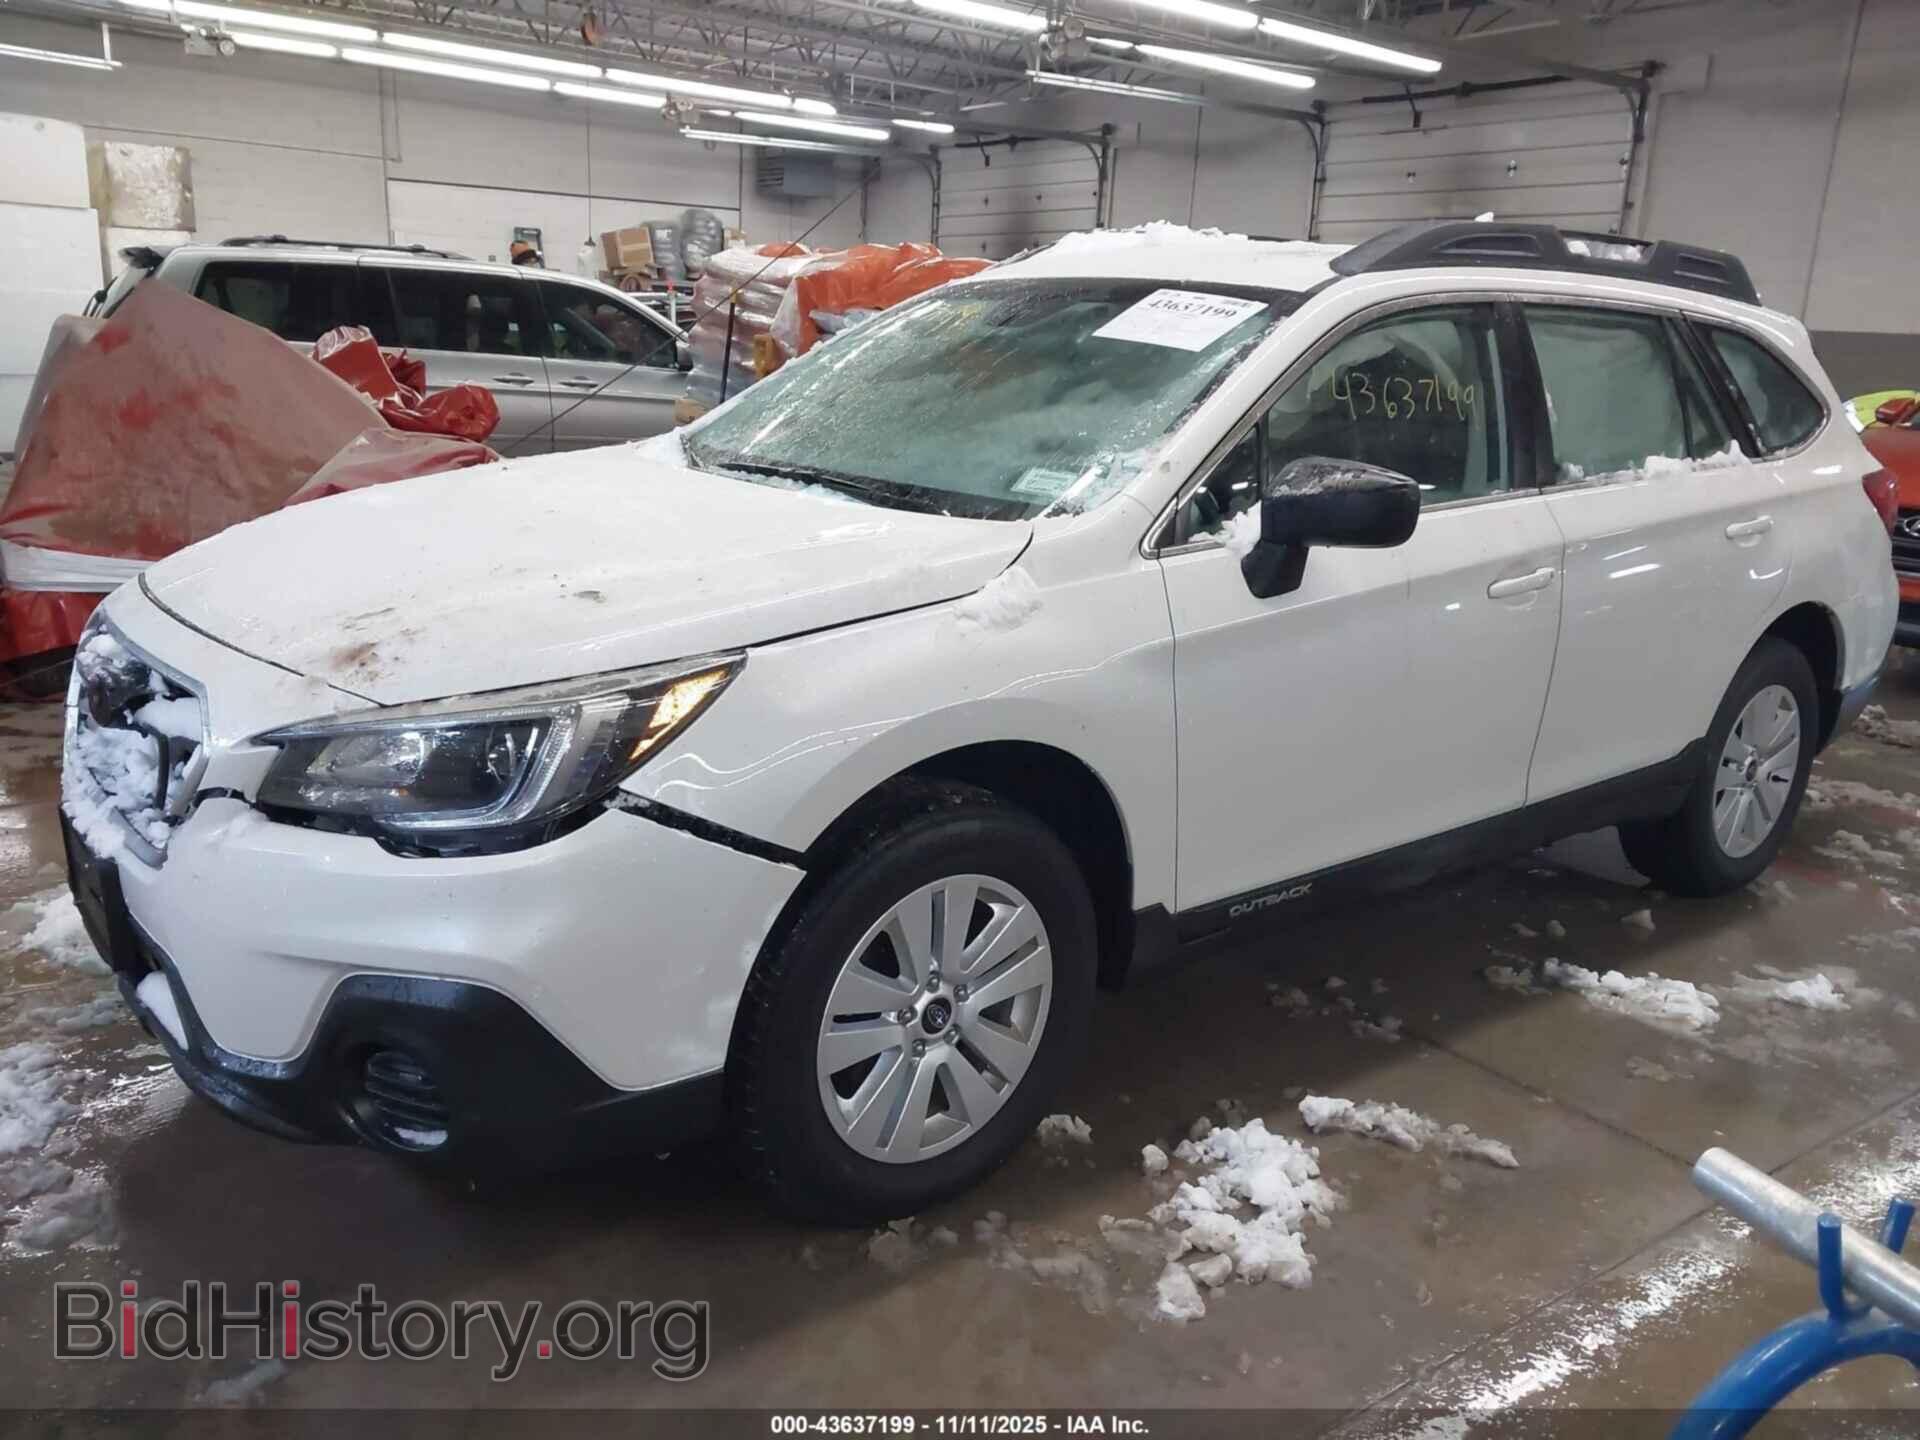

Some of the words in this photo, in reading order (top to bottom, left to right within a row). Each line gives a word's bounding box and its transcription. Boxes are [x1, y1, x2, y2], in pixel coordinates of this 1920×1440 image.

[1148, 298, 1238, 318] 43637199
[1331, 370, 1476, 421] 43637199
[1229, 882, 1312, 918] OUTBACK
